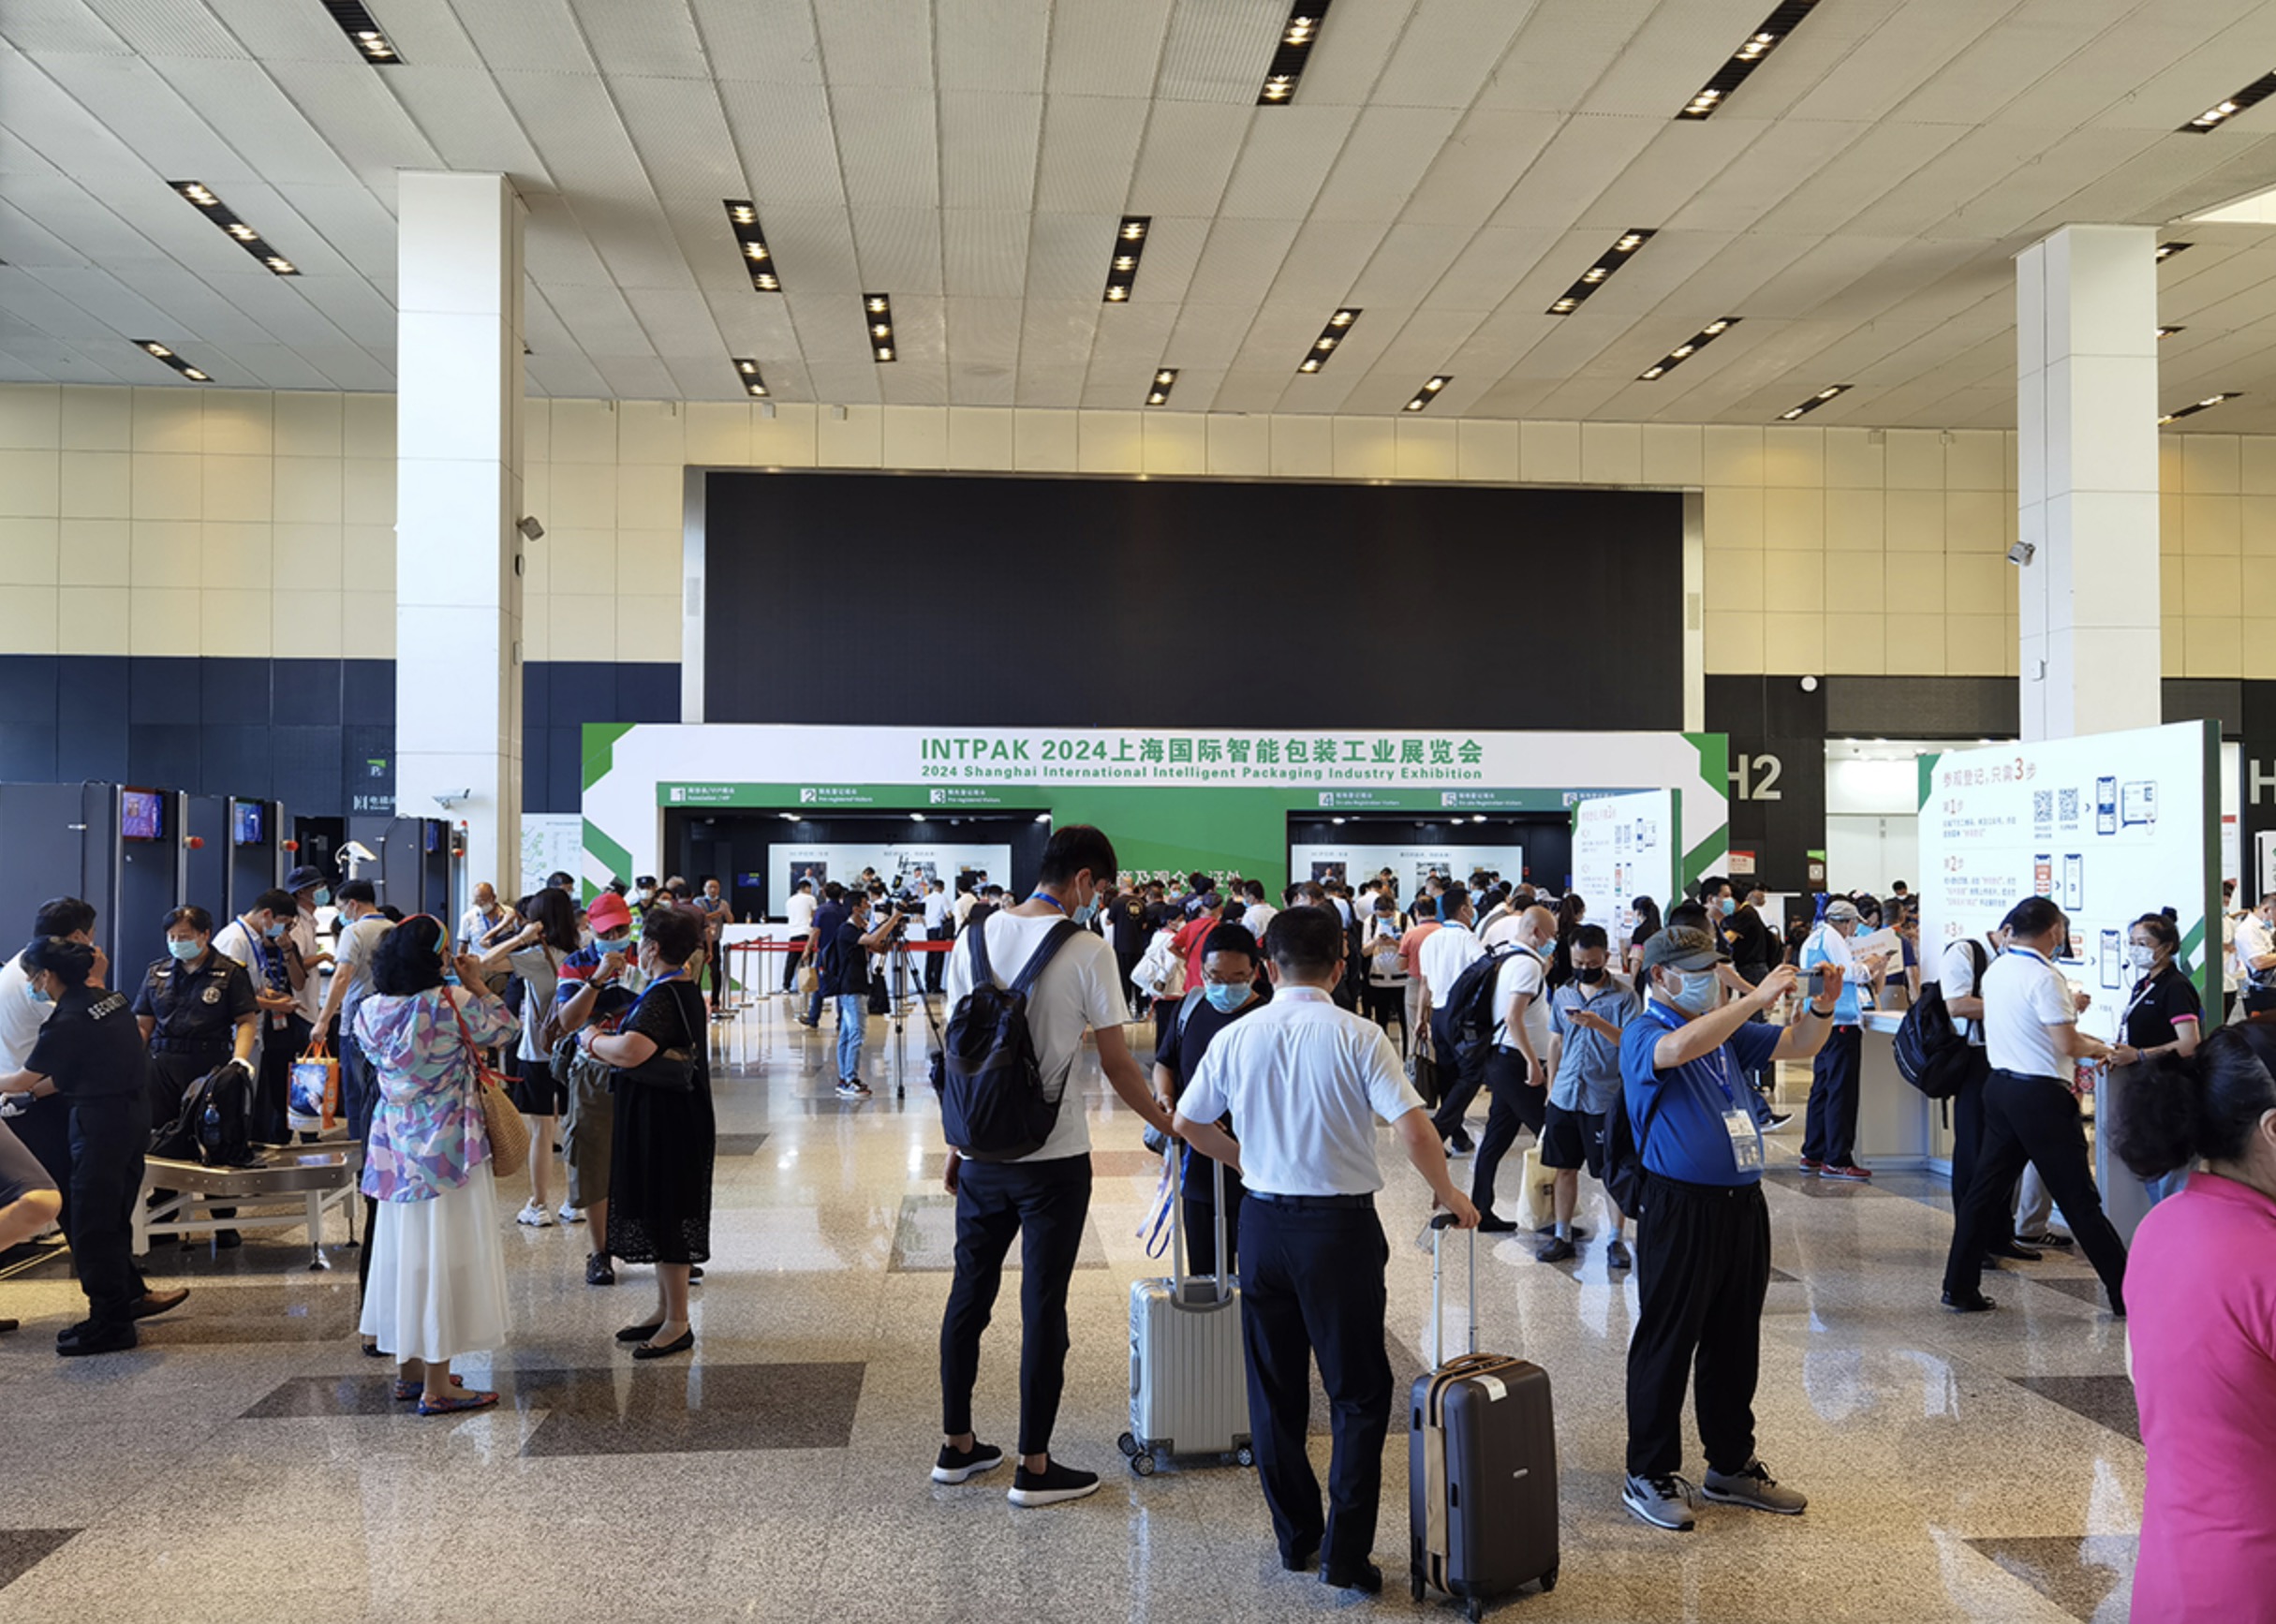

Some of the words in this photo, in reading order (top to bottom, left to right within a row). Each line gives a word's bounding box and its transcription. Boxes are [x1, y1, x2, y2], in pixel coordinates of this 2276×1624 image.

[921, 739, 1030, 760] INTPAK
[1041, 738, 1483, 763] 2024上海国际智能包装工业展览会
[921, 765, 958, 778] 2024
[964, 765, 1038, 780] Shanghai
[1042, 765, 1147, 778] International
[1153, 765, 1236, 781] Intelligent
[1242, 766, 1323, 781] Packaging
[1328, 766, 1395, 781] Industry
[1400, 766, 1483, 779] Exhibition
[1727, 754, 1782, 801] H2
